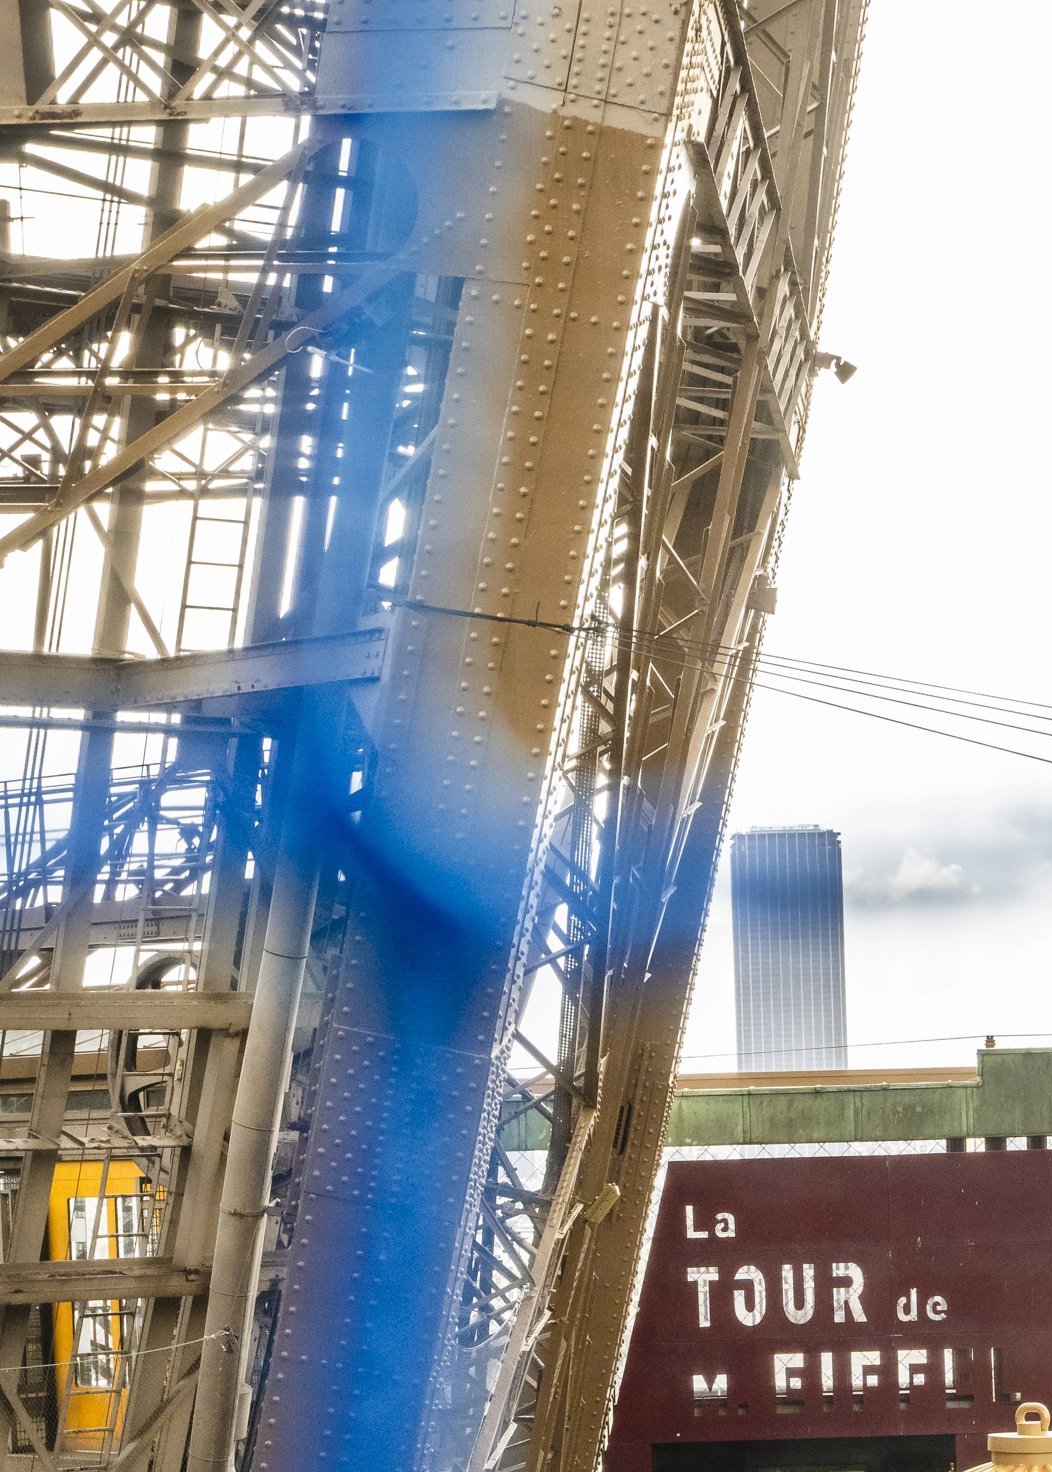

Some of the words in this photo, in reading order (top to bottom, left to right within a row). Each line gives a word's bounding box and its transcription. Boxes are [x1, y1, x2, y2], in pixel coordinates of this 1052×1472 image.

[685, 1205, 737, 1239] La
[686, 1262, 868, 1328] TOUR
[896, 1288, 948, 1322] de
[692, 1374, 749, 1416] M.
[773, 1347, 1022, 1414] EIFFEL
